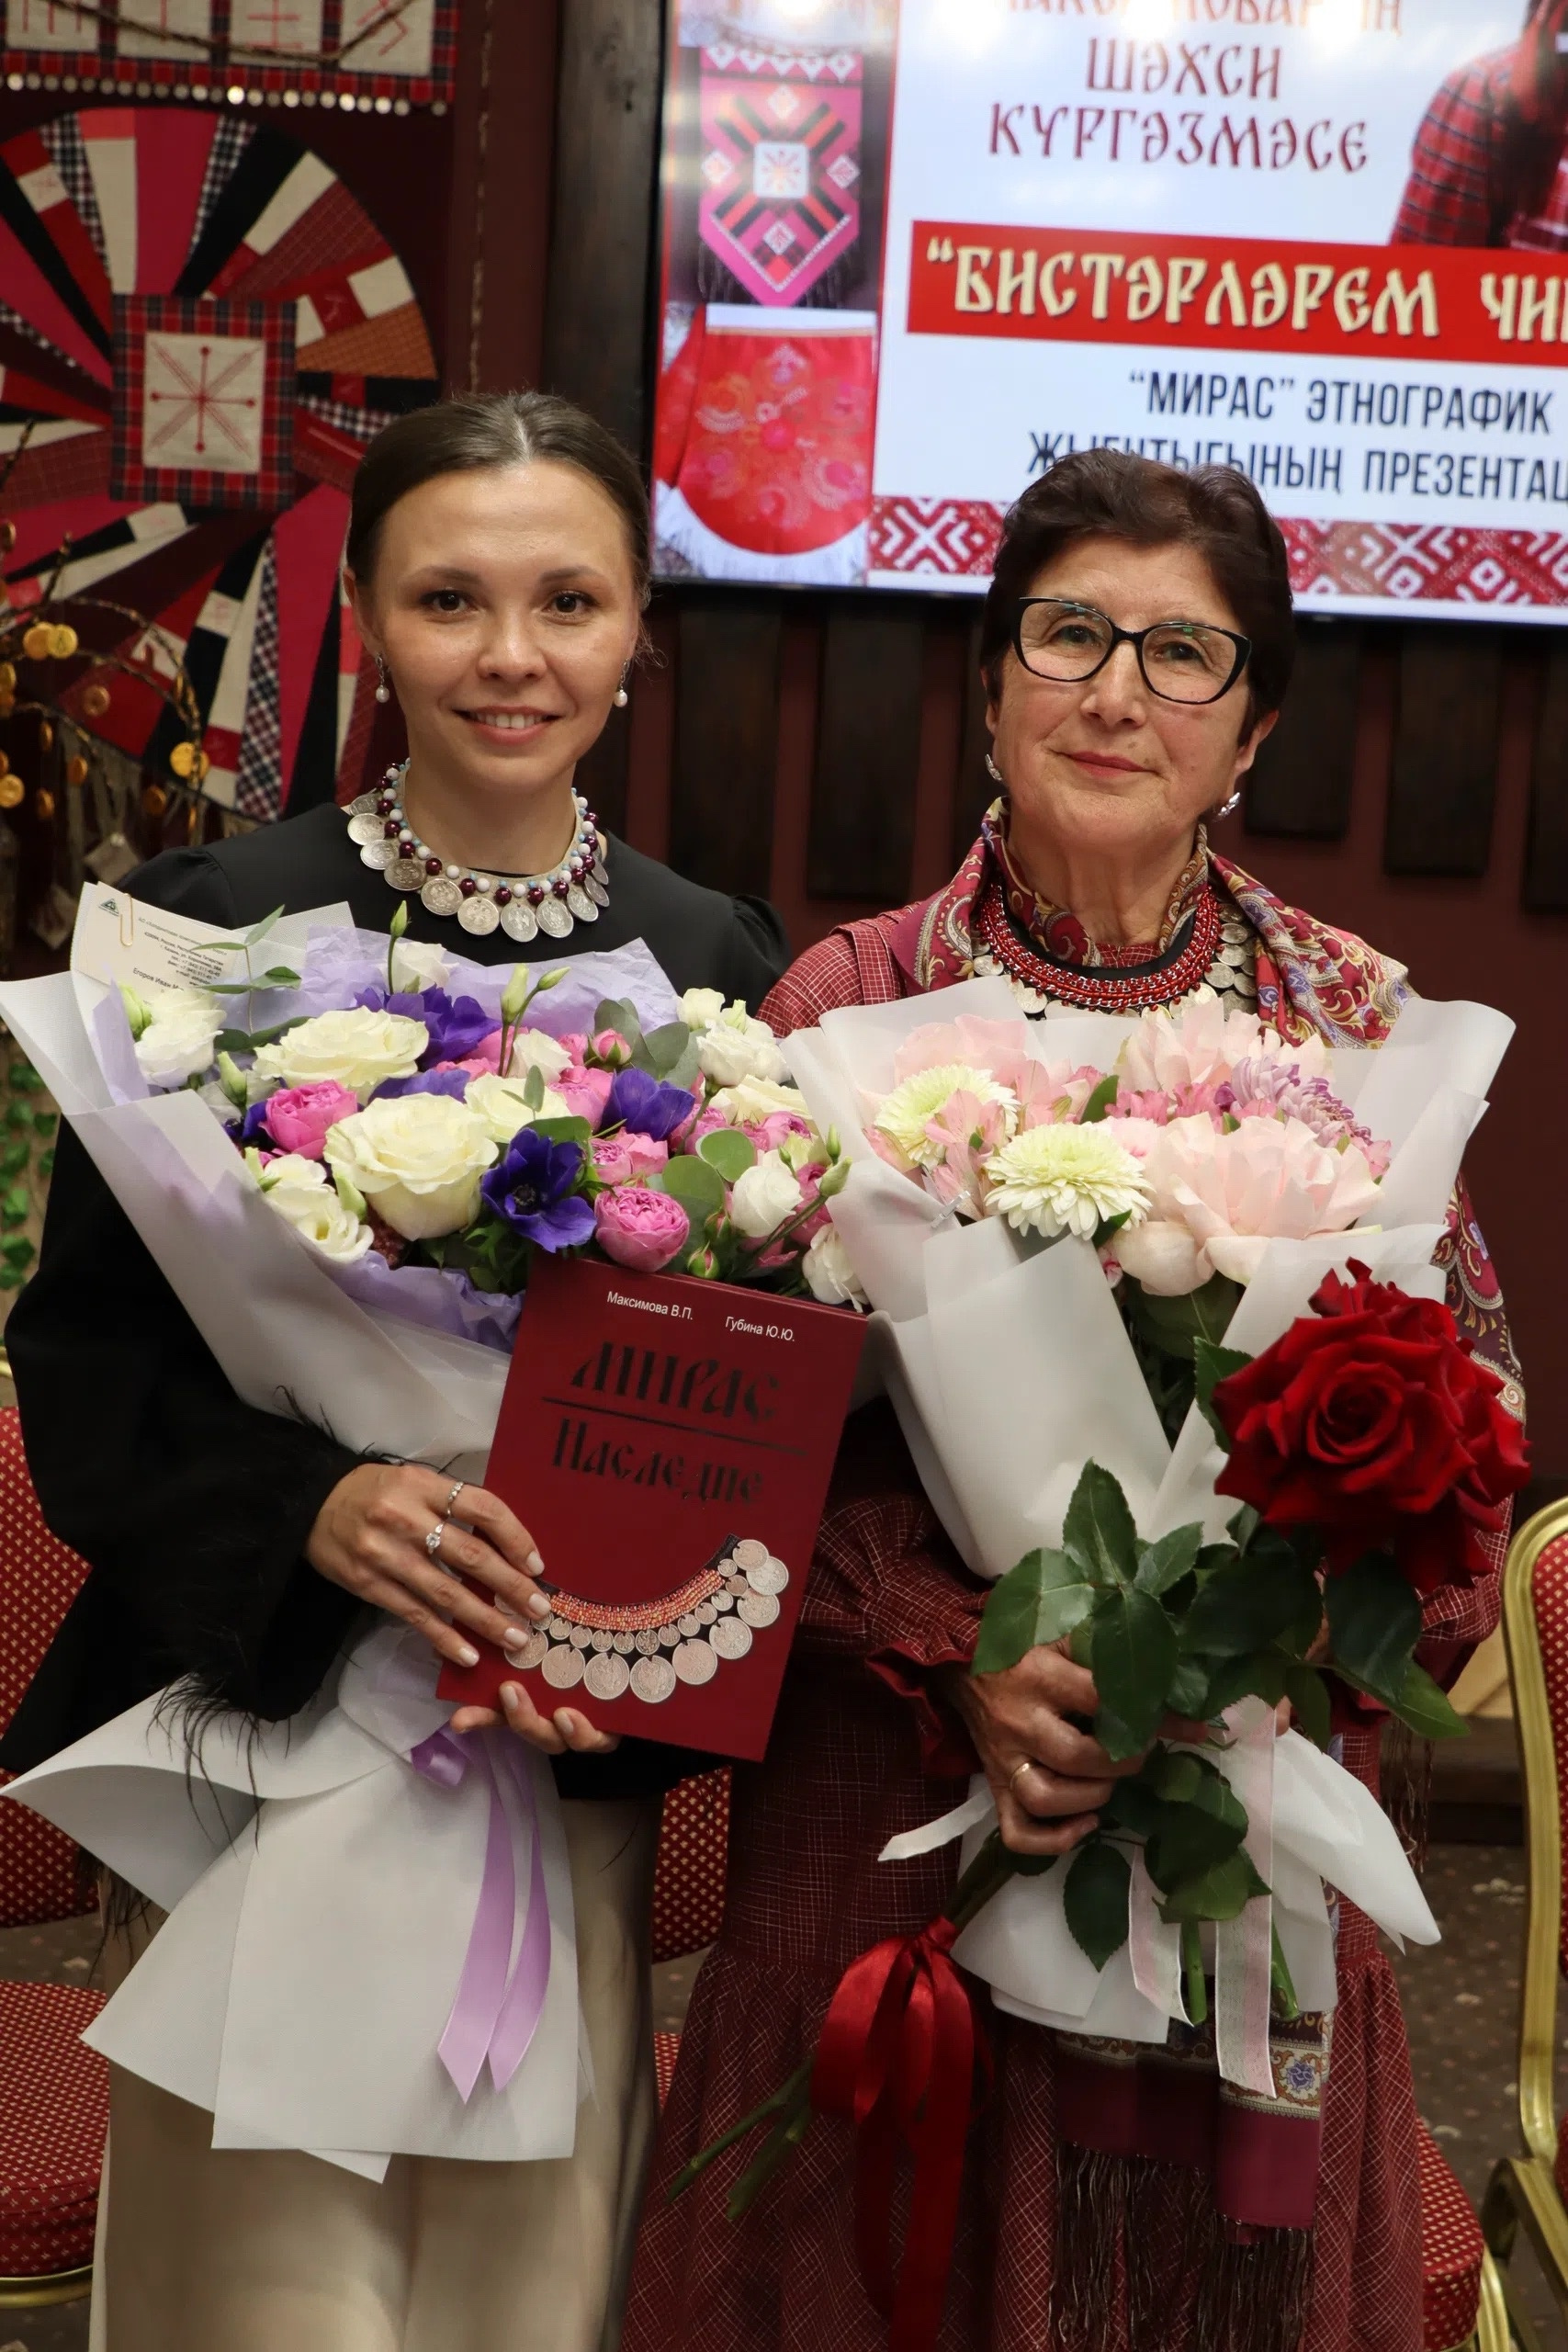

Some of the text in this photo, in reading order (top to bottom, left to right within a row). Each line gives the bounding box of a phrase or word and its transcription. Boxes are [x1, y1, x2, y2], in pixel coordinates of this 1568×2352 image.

[1087, 38, 1281, 100] ШӘХСИ
[1480, 272, 1568, 344] ЧИ
[1306, 379, 1554, 435] ЭТНОГРАФИК
[606, 1290, 694, 1320] Максимова В.П.
[725, 1316, 795, 1342] Губина Ю.Ю.
